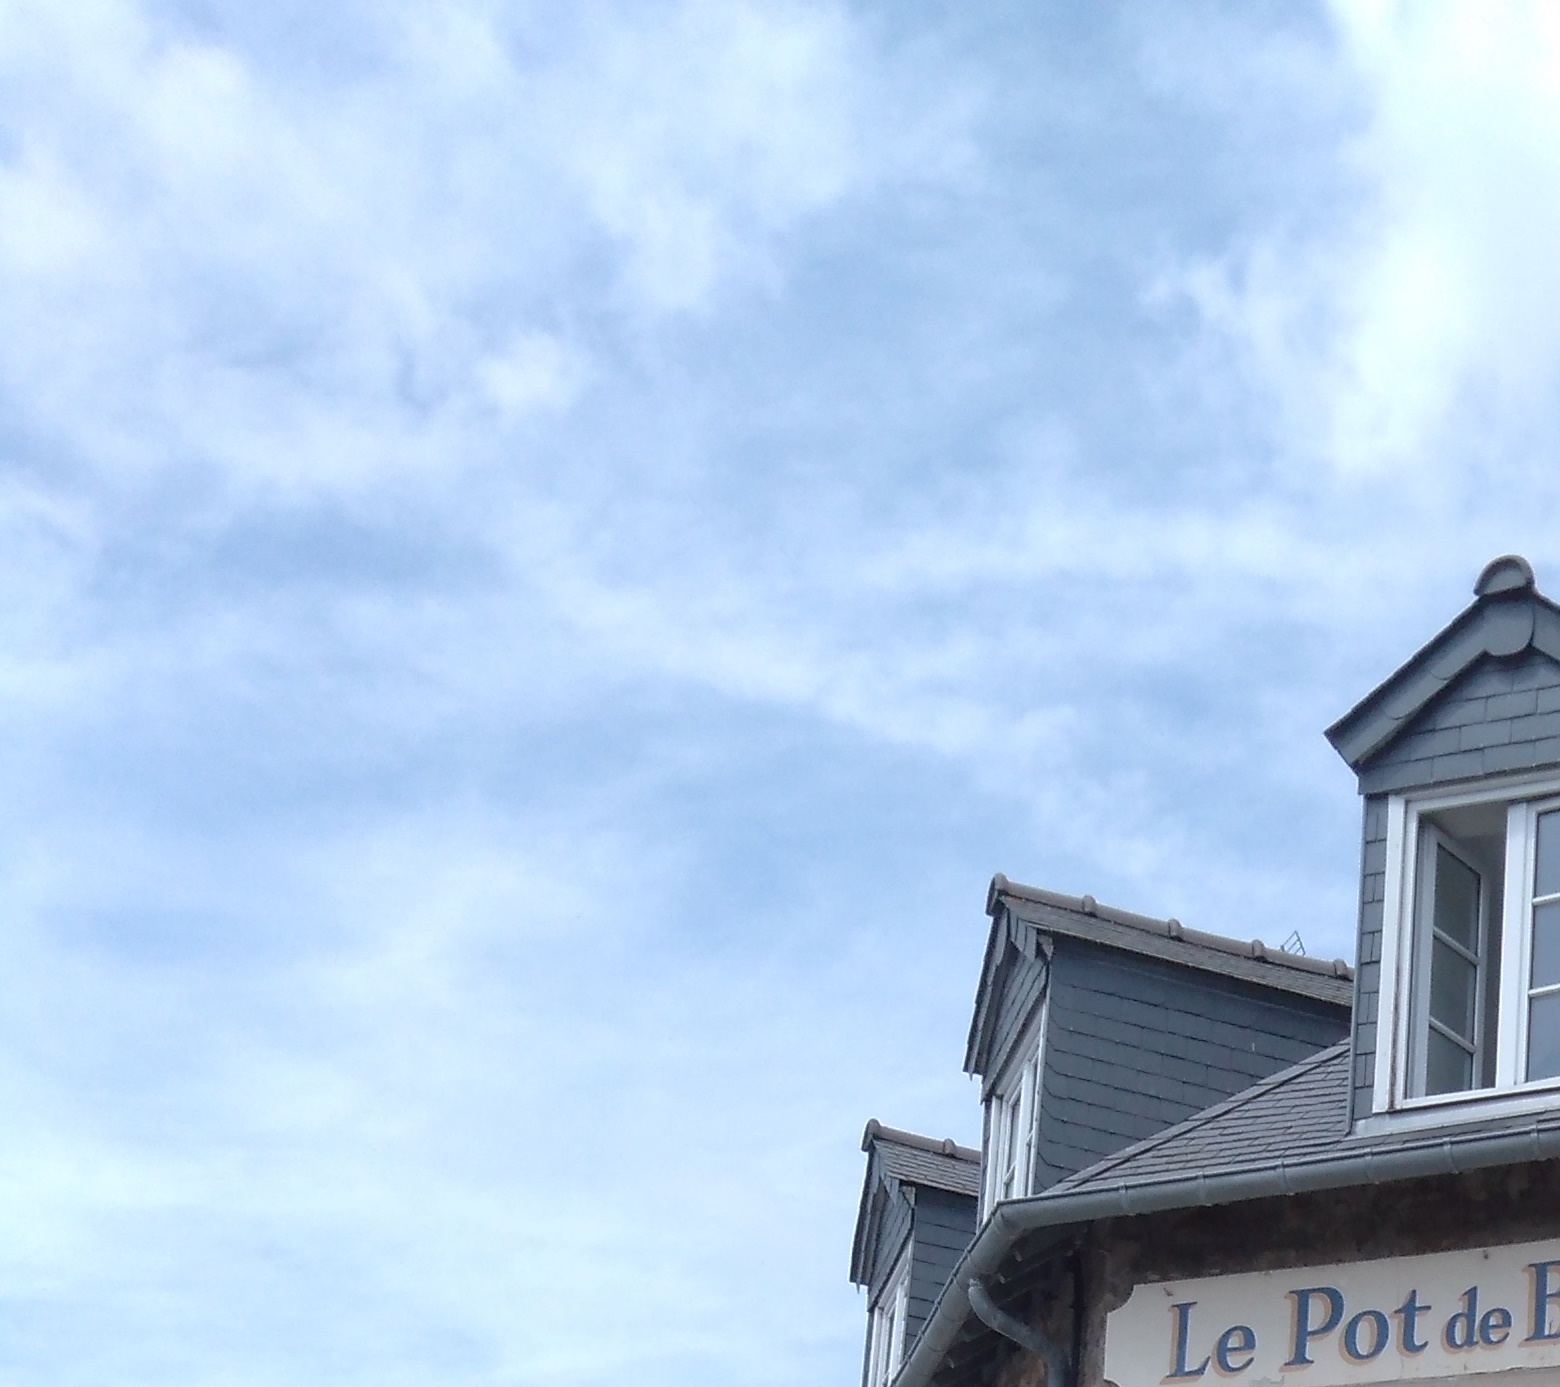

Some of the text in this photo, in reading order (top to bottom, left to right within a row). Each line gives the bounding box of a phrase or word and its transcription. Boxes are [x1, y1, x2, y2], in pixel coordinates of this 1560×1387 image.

[1164, 1300, 1257, 1382] Le
[1281, 1285, 1432, 1372] Pot
[1444, 1286, 1513, 1351] de
